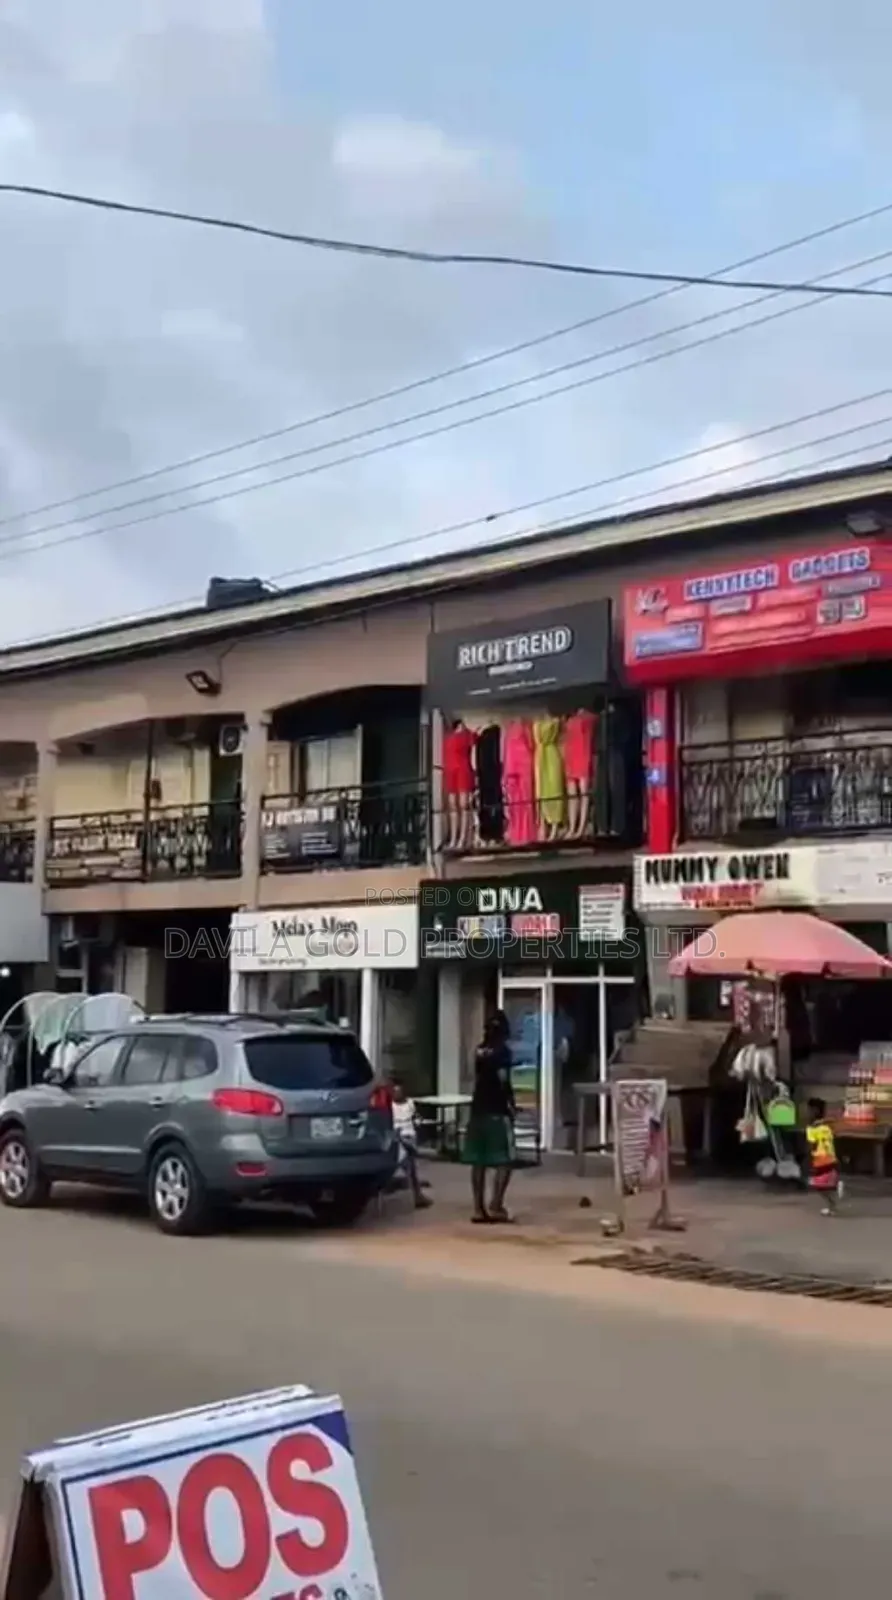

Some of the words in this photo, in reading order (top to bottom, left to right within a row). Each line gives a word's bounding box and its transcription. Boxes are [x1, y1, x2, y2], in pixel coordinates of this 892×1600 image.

[683, 564, 779, 602] KENNYTECH
[458, 641, 501, 668] RICH
[504, 627, 571, 661] TREND
[644, 856, 719, 884] MUMMY
[477, 886, 544, 913] DNA
[88, 1432, 349, 1600] POS
